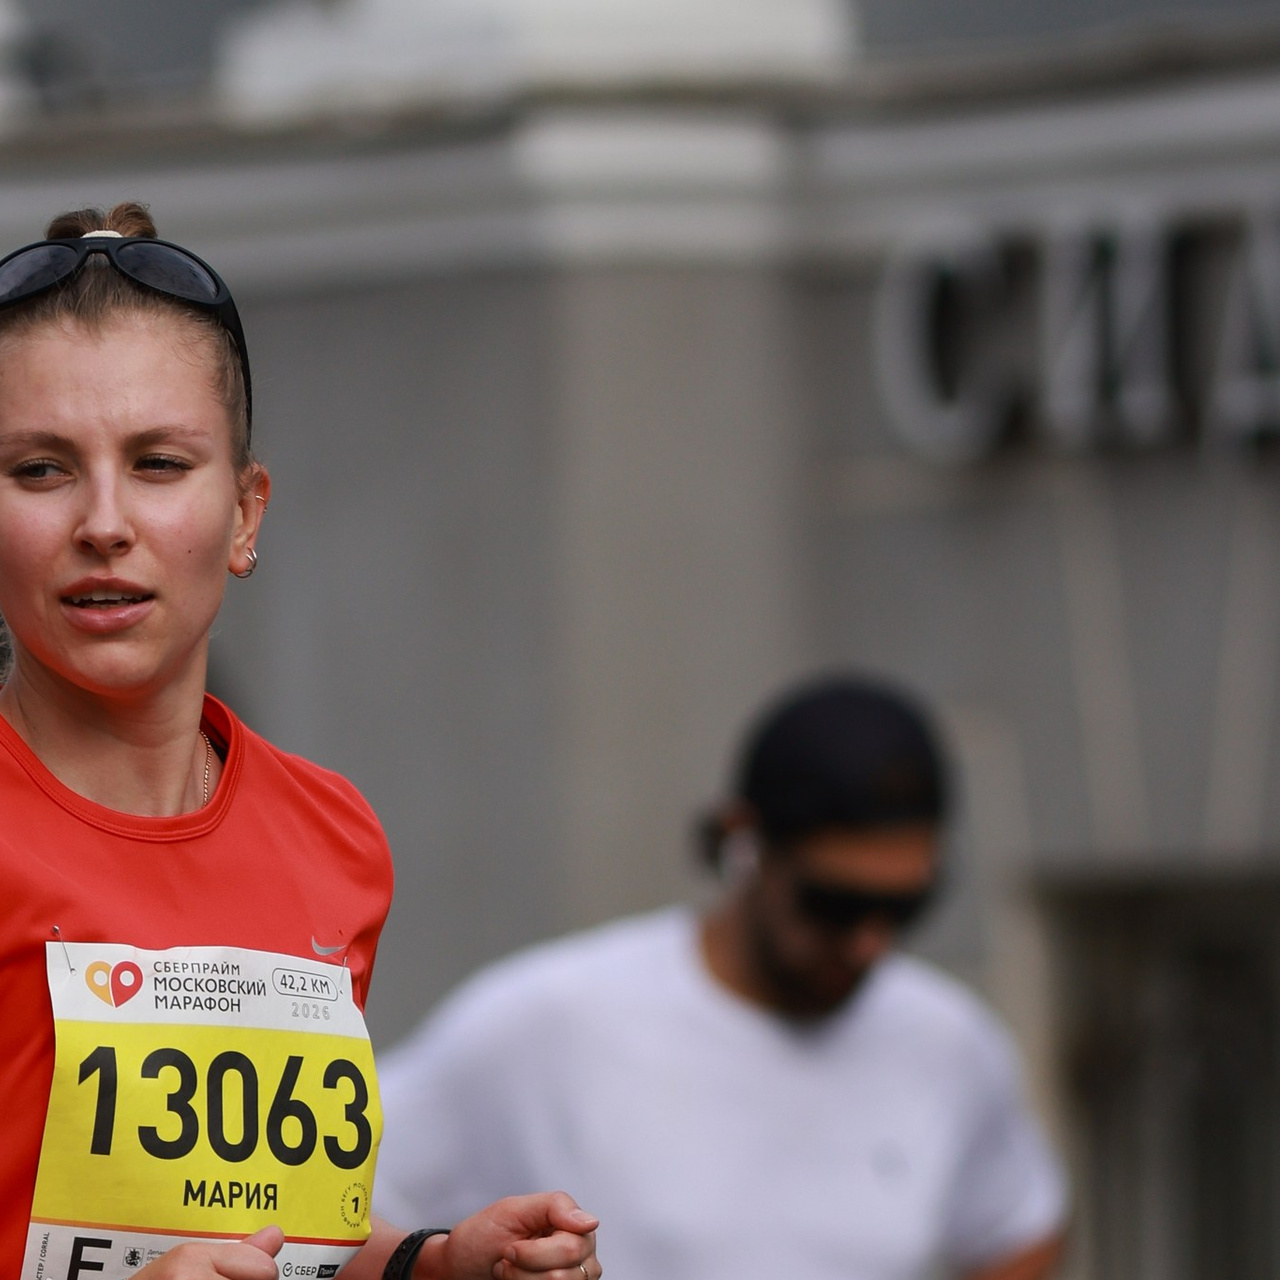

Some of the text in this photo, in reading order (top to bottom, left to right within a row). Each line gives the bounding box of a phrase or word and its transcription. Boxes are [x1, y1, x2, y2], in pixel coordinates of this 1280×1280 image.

[153, 961, 241, 976] СБЕРПРАЙМ
[153, 977, 267, 997] МОСКОВСКИЙ
[280, 973, 331, 995] 42,2 КМ
[154, 995, 241, 1013] МАРАФОН
[291, 1001, 331, 1021] 2026
[77, 1045, 373, 1171] 13063
[182, 1179, 279, 1211] МАРИЯ
[351, 1196, 360, 1214] 1
[40, 1232, 50, 1258] CORRAL
[294, 1265, 318, 1276] СБЕР
